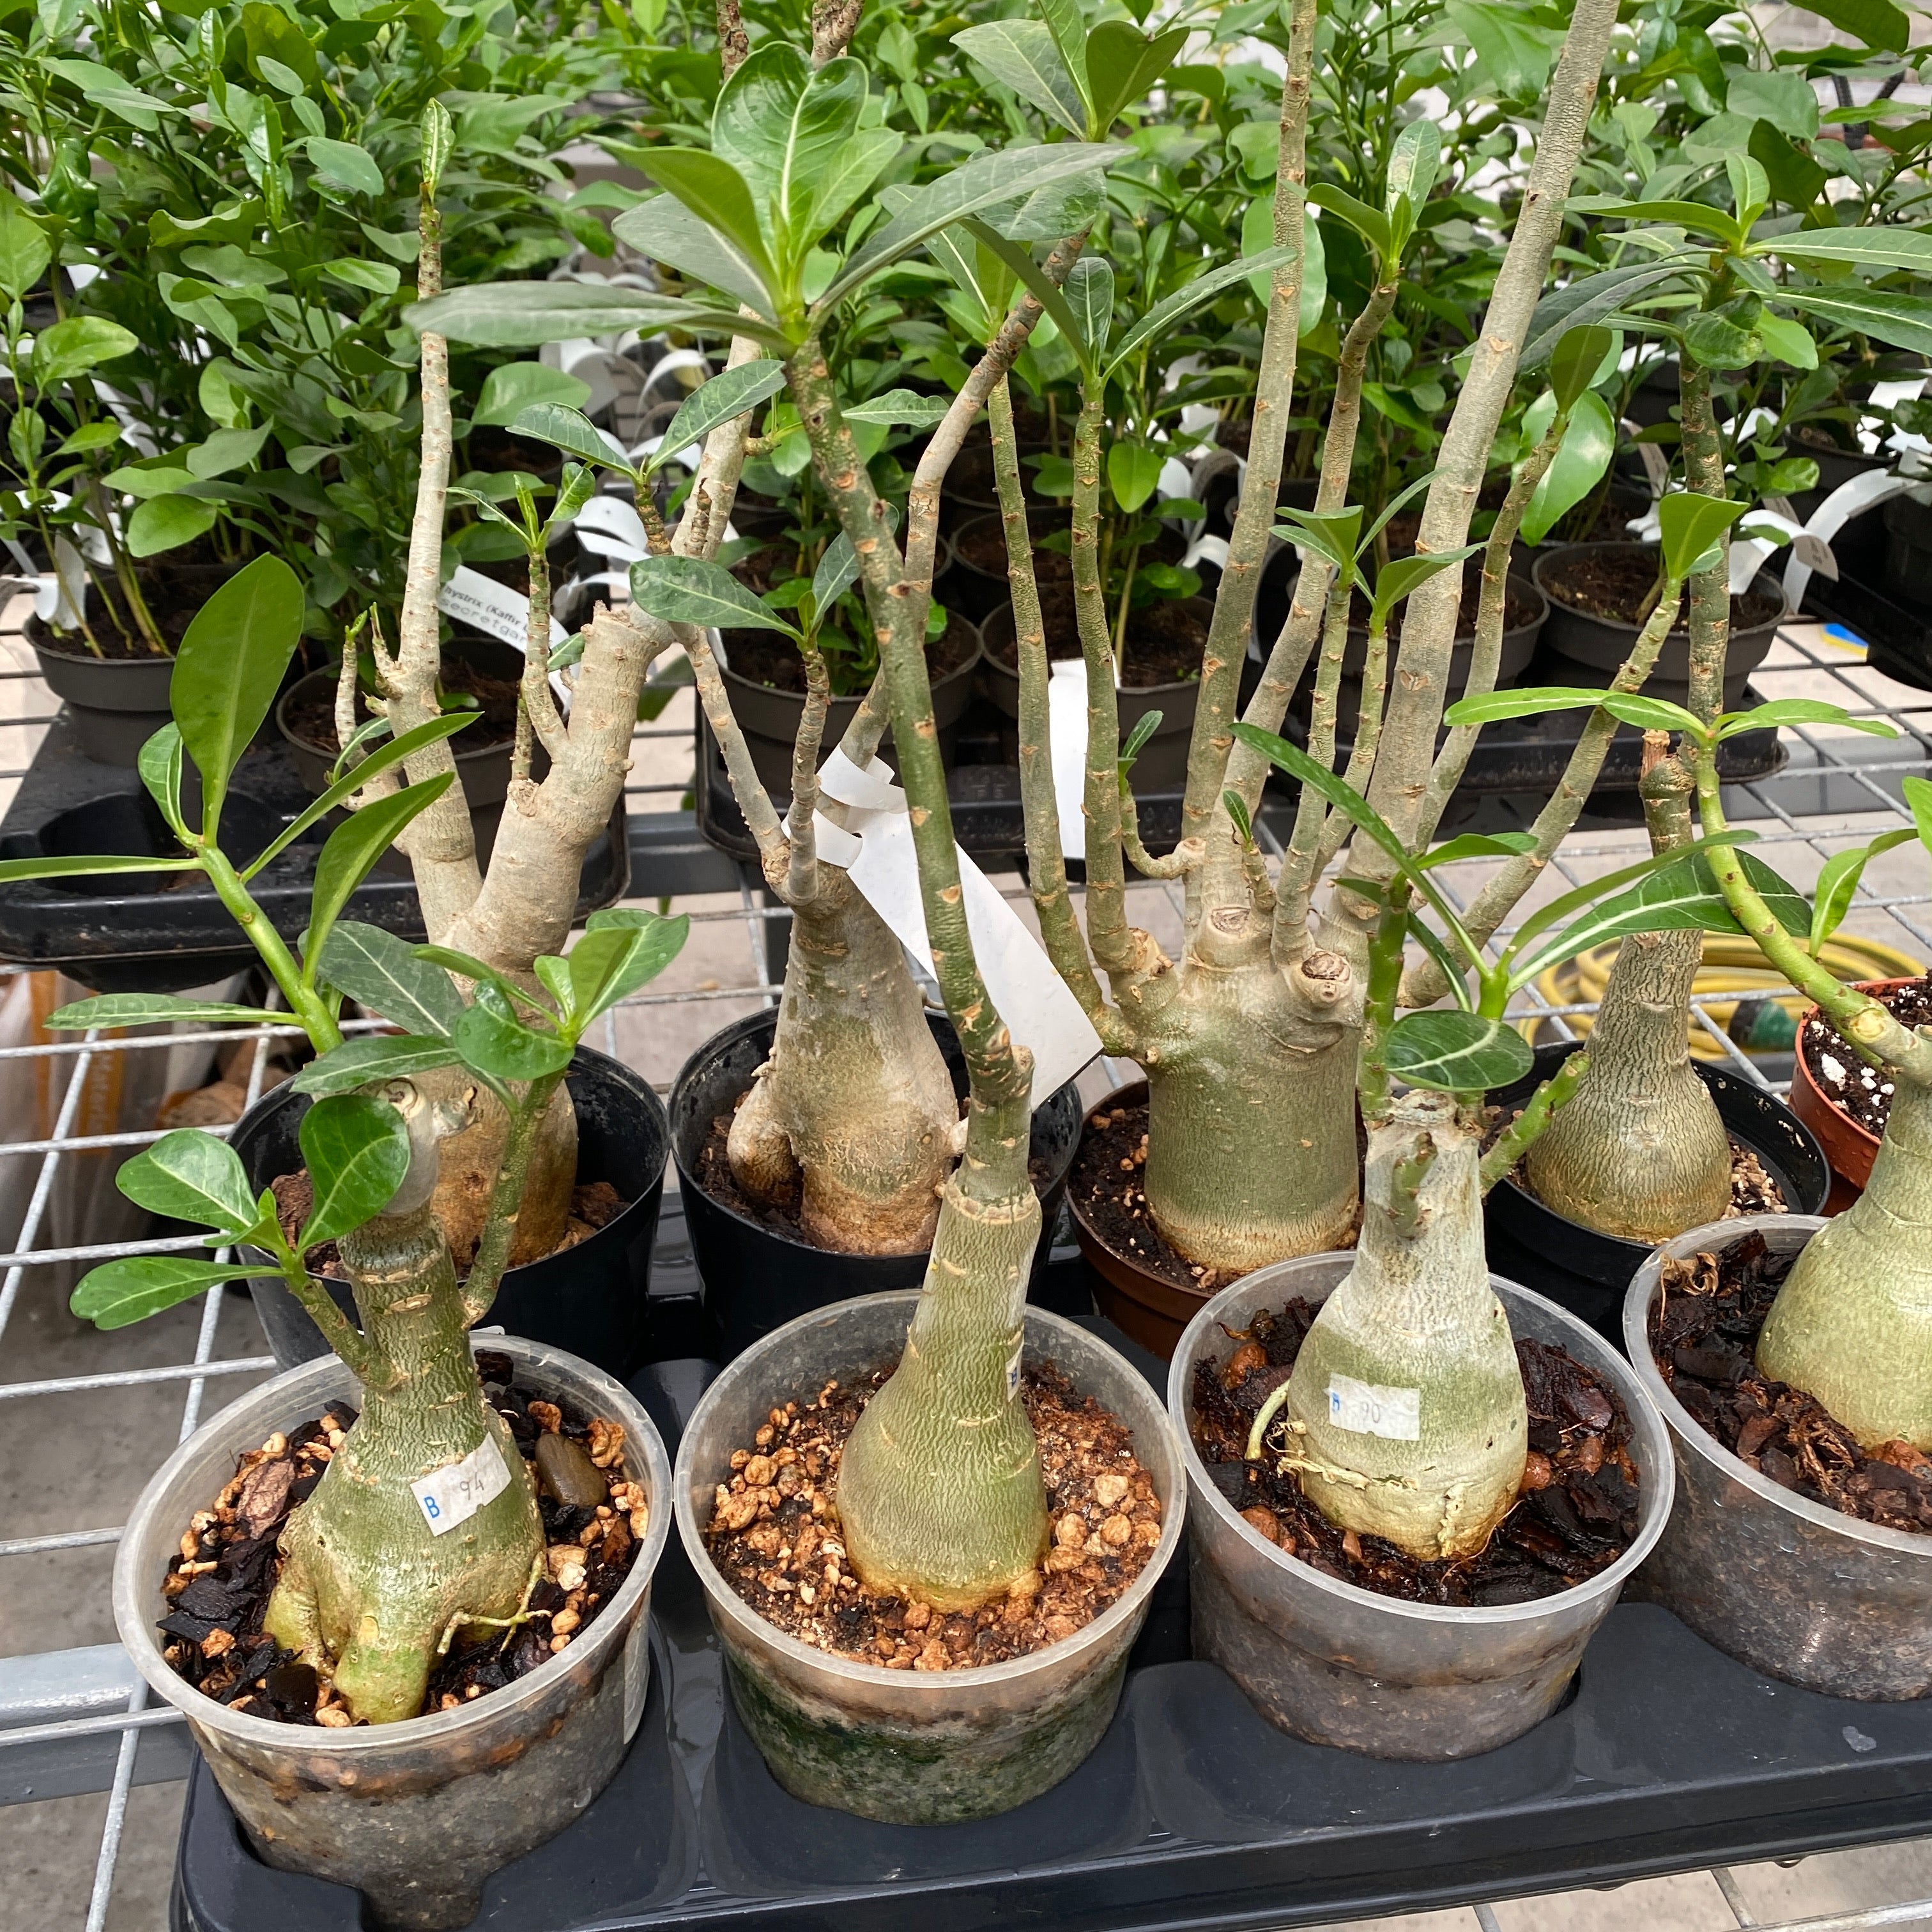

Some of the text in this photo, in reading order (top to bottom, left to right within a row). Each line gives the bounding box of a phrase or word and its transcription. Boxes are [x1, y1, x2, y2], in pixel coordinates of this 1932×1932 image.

[444, 586, 484, 608] hystrix
[440, 598, 527, 642] secretgar
[424, 1471, 485, 1519] B 94
